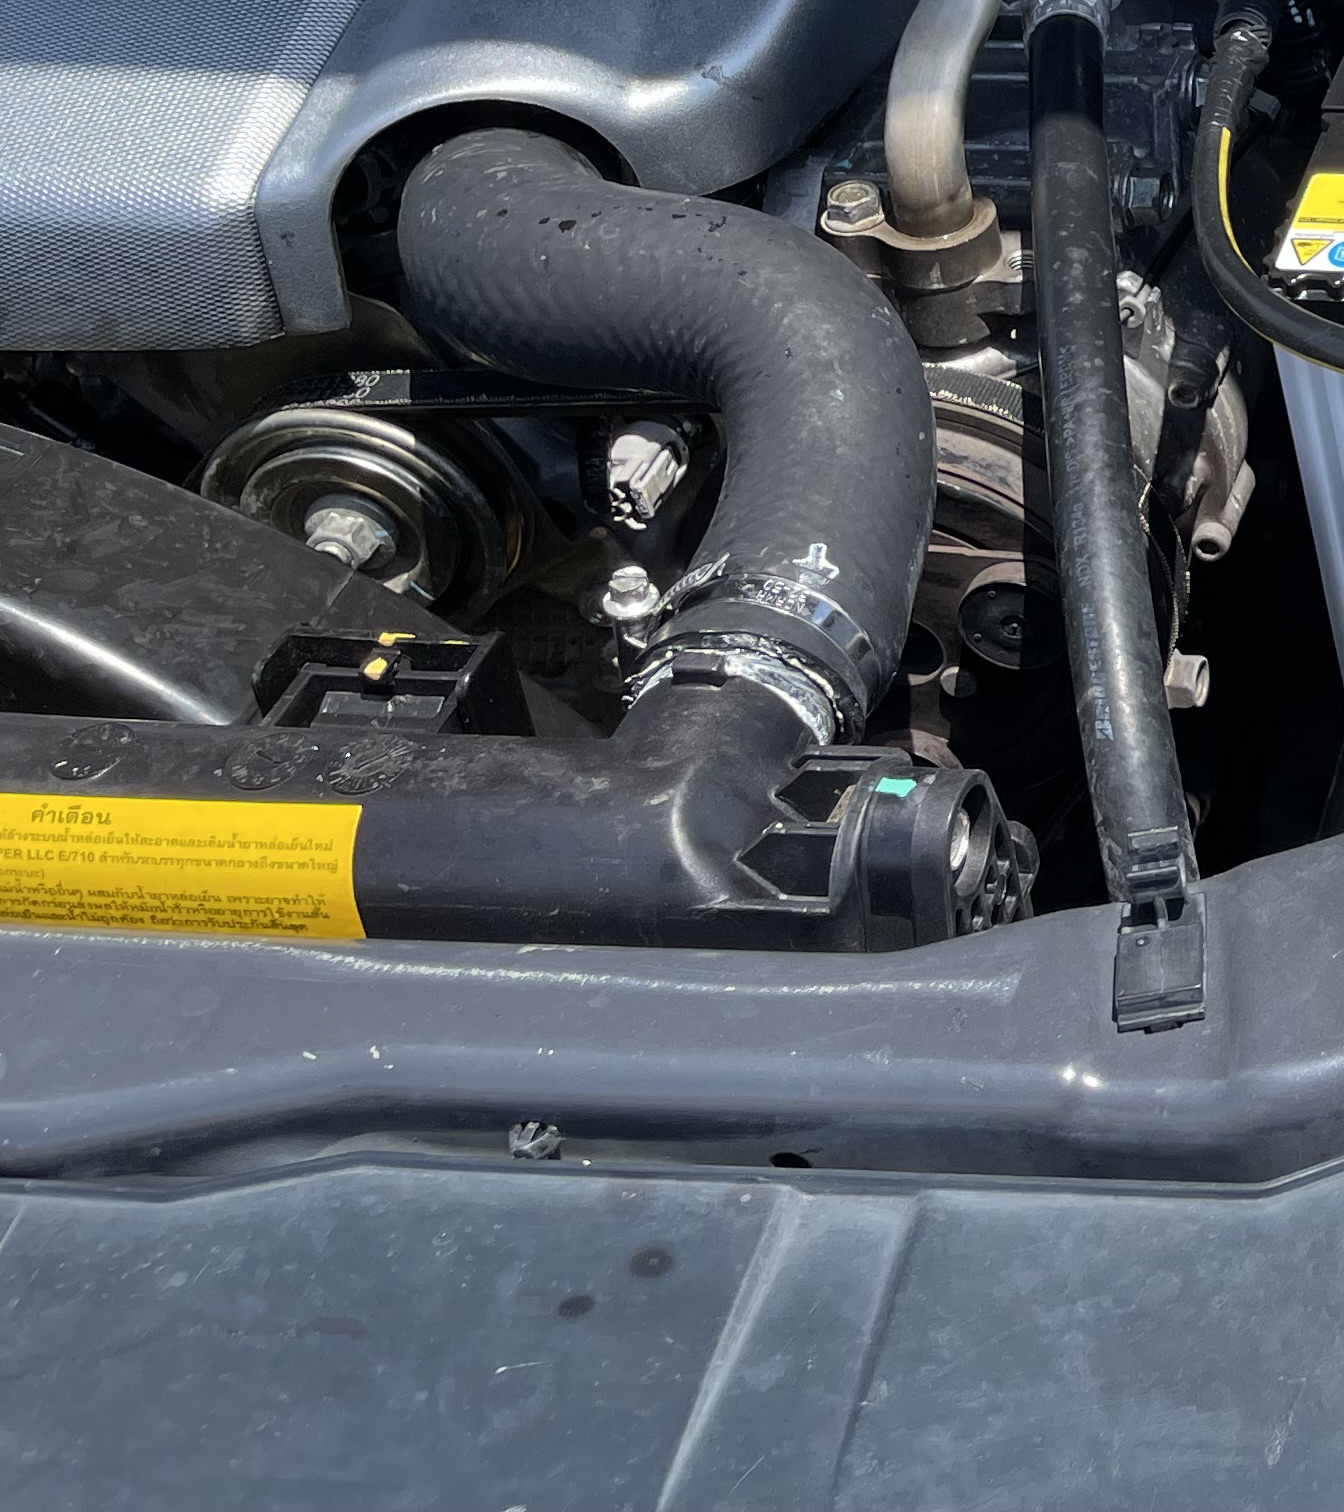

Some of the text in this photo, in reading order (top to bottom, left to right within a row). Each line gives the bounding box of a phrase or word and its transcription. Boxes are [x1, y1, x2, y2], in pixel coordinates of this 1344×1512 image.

[30, 801, 113, 827] คำเตือน
[27, 849, 55, 862] LLC
[58, 848, 95, 864] E/710
